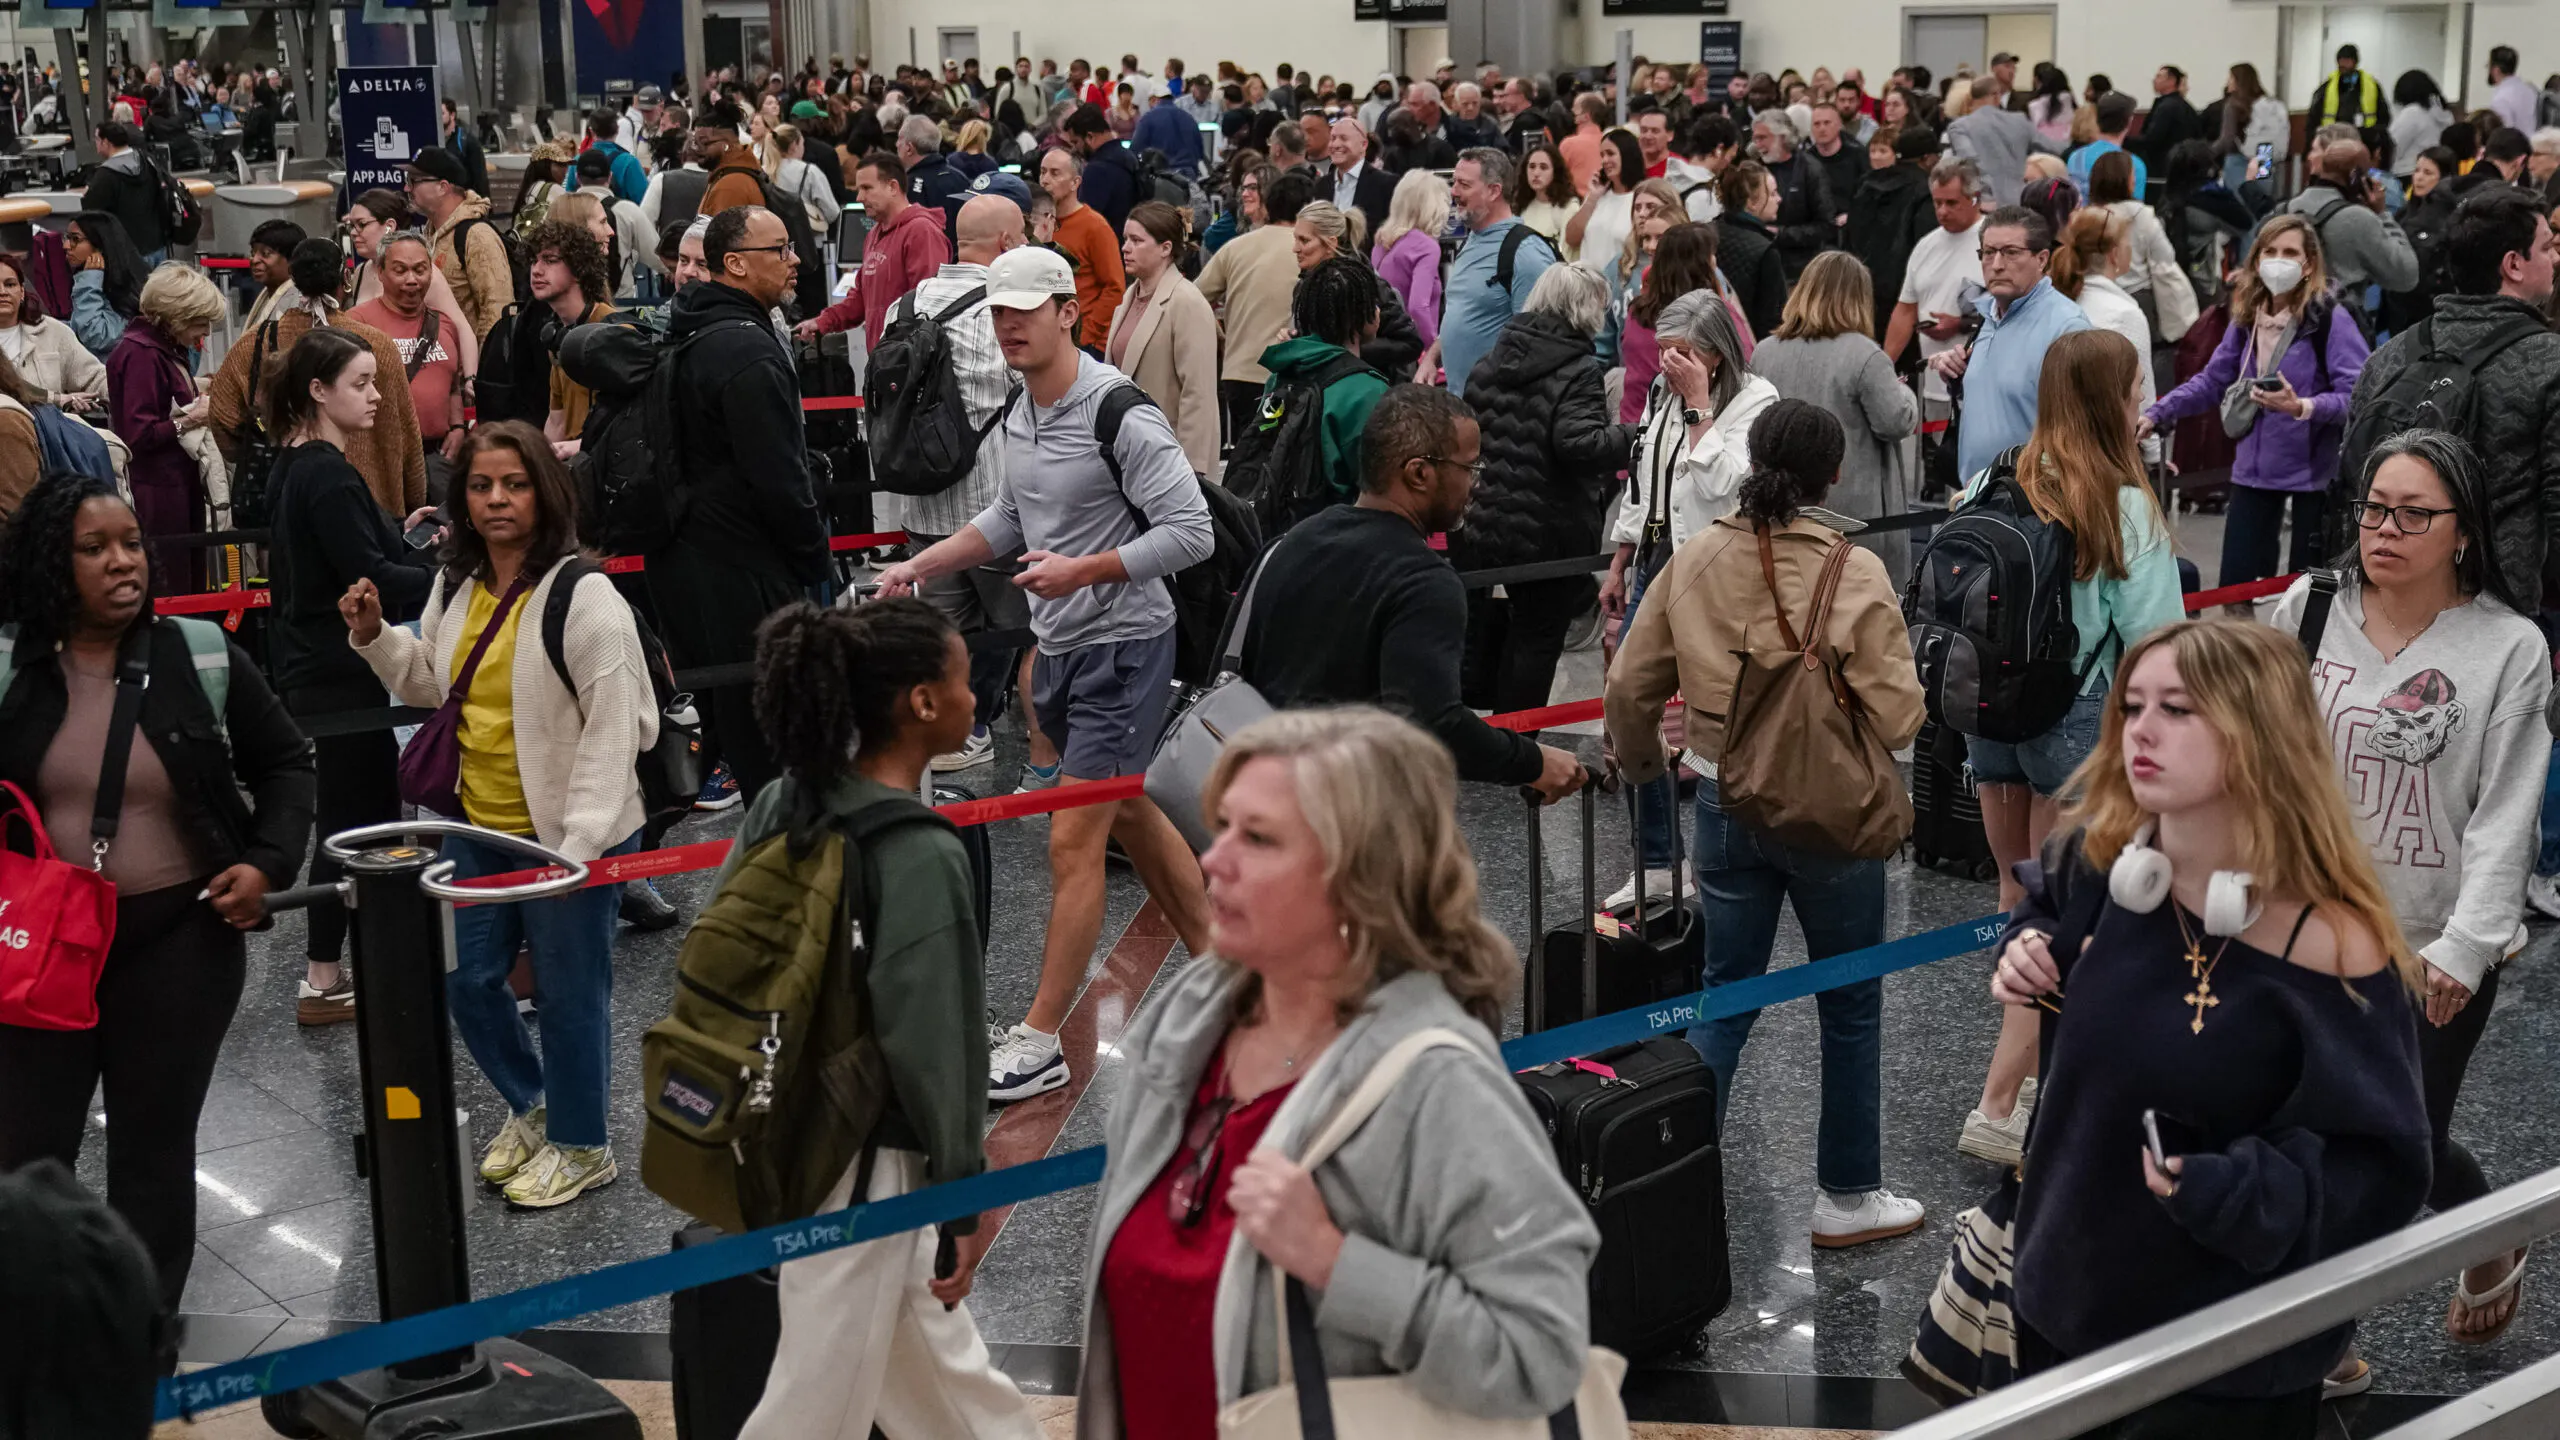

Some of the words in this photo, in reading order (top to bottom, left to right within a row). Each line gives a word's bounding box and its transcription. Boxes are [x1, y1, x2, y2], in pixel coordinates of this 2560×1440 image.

[363, 79, 412, 92] DELTA
[352, 170, 375, 183] APP
[377, 170, 402, 183] BAG
[252, 591, 272, 605] AT
[0, 925, 31, 950] AG
[1973, 924, 1996, 943] TSA
[1995, 922, 2008, 938] Pr
[1646, 1010, 1672, 1030] TSA
[1672, 1006, 1694, 1023] Pre
[772, 1230, 809, 1256] TSA
[809, 1224, 842, 1247] Pre
[215, 1374, 256, 1399] Pre
